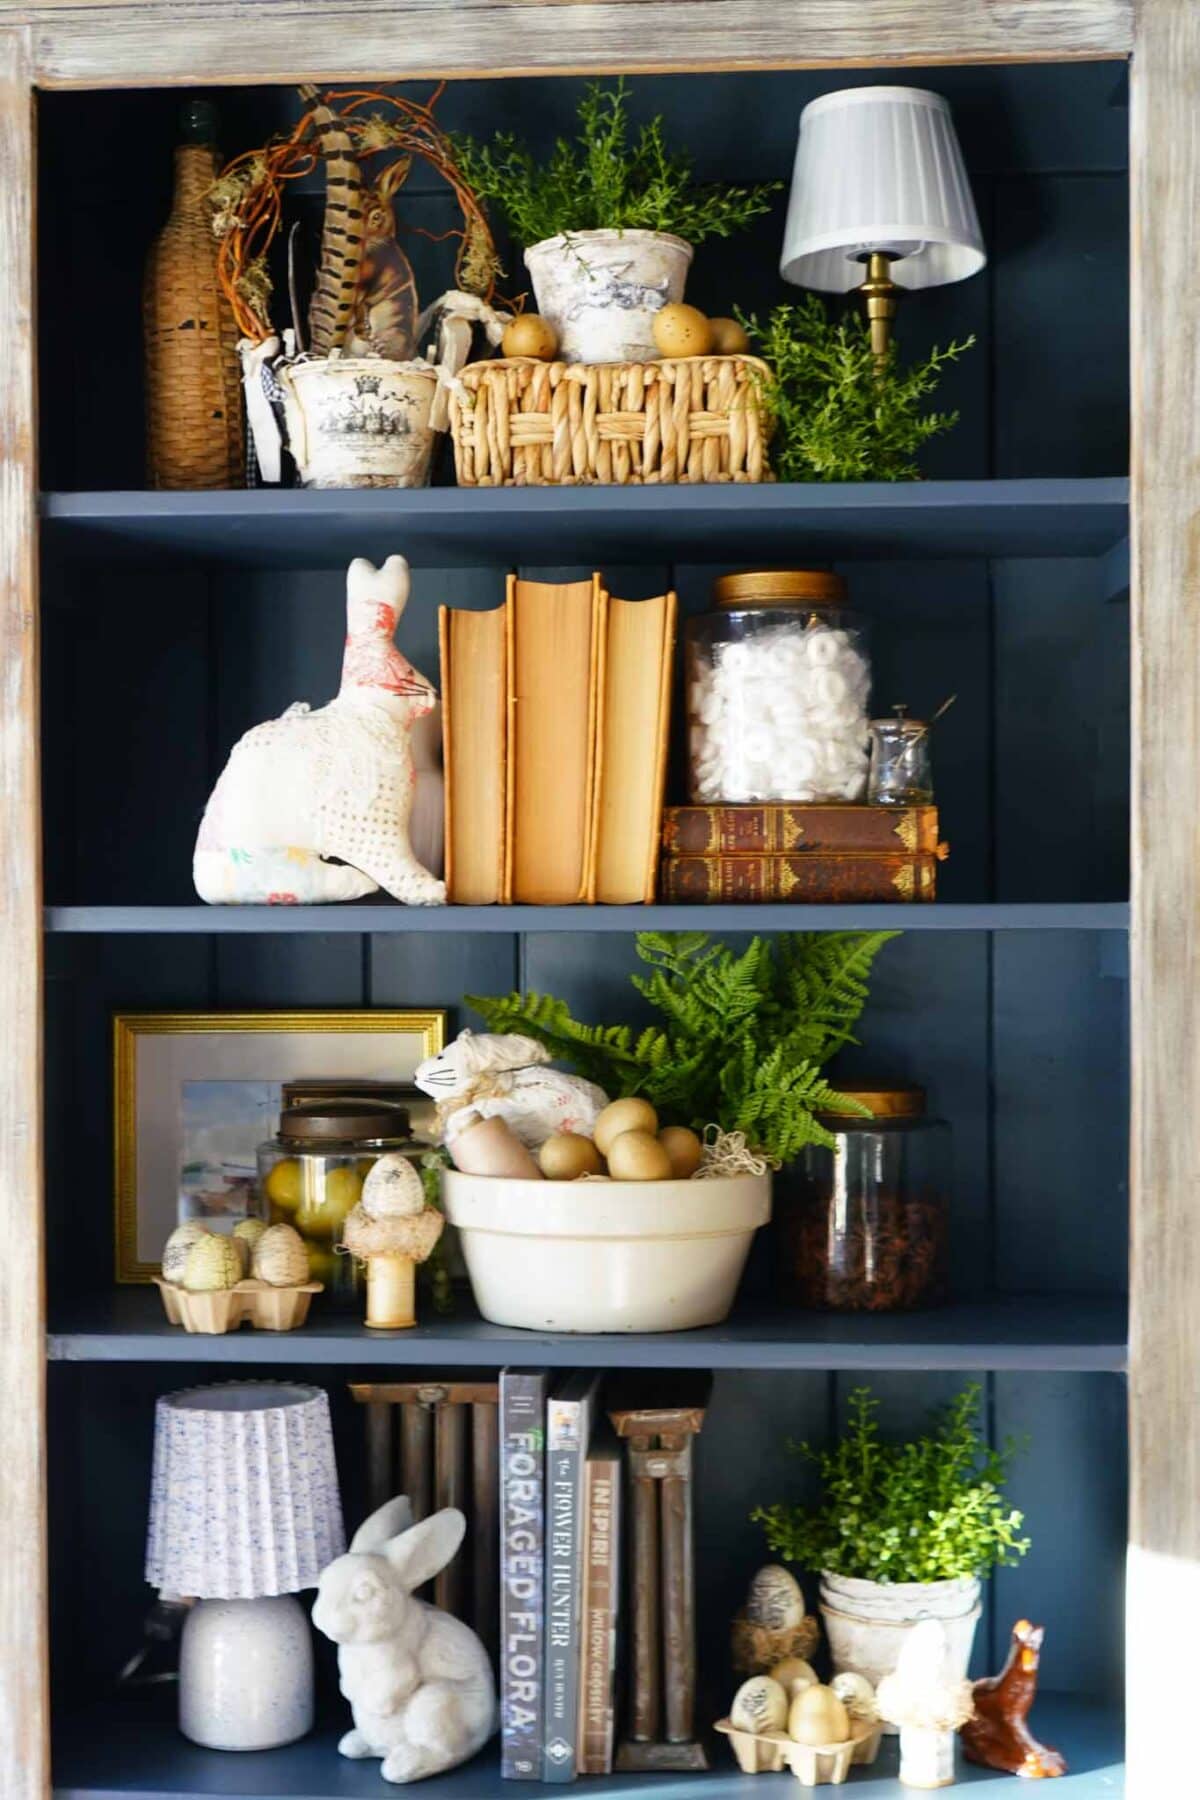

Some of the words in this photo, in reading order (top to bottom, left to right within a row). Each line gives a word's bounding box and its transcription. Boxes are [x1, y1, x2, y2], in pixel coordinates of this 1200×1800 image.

[507, 1432, 538, 1599] FORAGED
[552, 1481, 574, 1557] FLOWER
[591, 1479, 611, 1566] INSPIRE
[550, 1564, 573, 1646] HUNTER
[507, 1611, 537, 1729] FLORA
